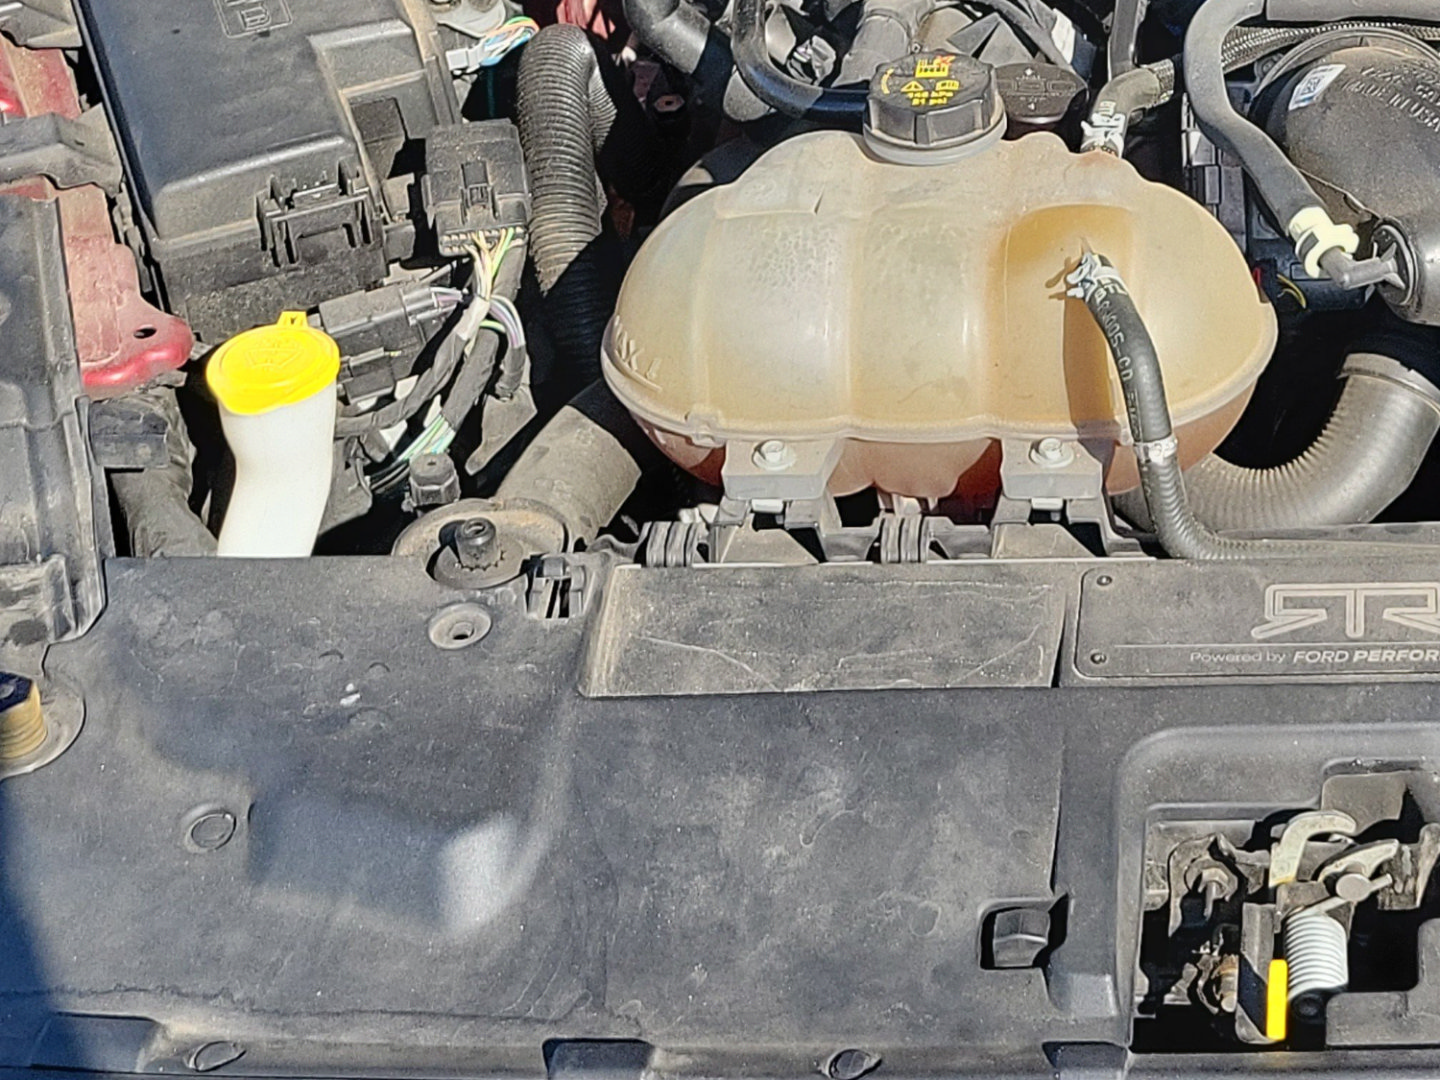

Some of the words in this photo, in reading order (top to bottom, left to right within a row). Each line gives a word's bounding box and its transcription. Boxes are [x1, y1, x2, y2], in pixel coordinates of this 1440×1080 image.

[1189, 651, 1263, 663] Powered
[1266, 650, 1286, 664] by
[1292, 650, 1350, 663] FORD
